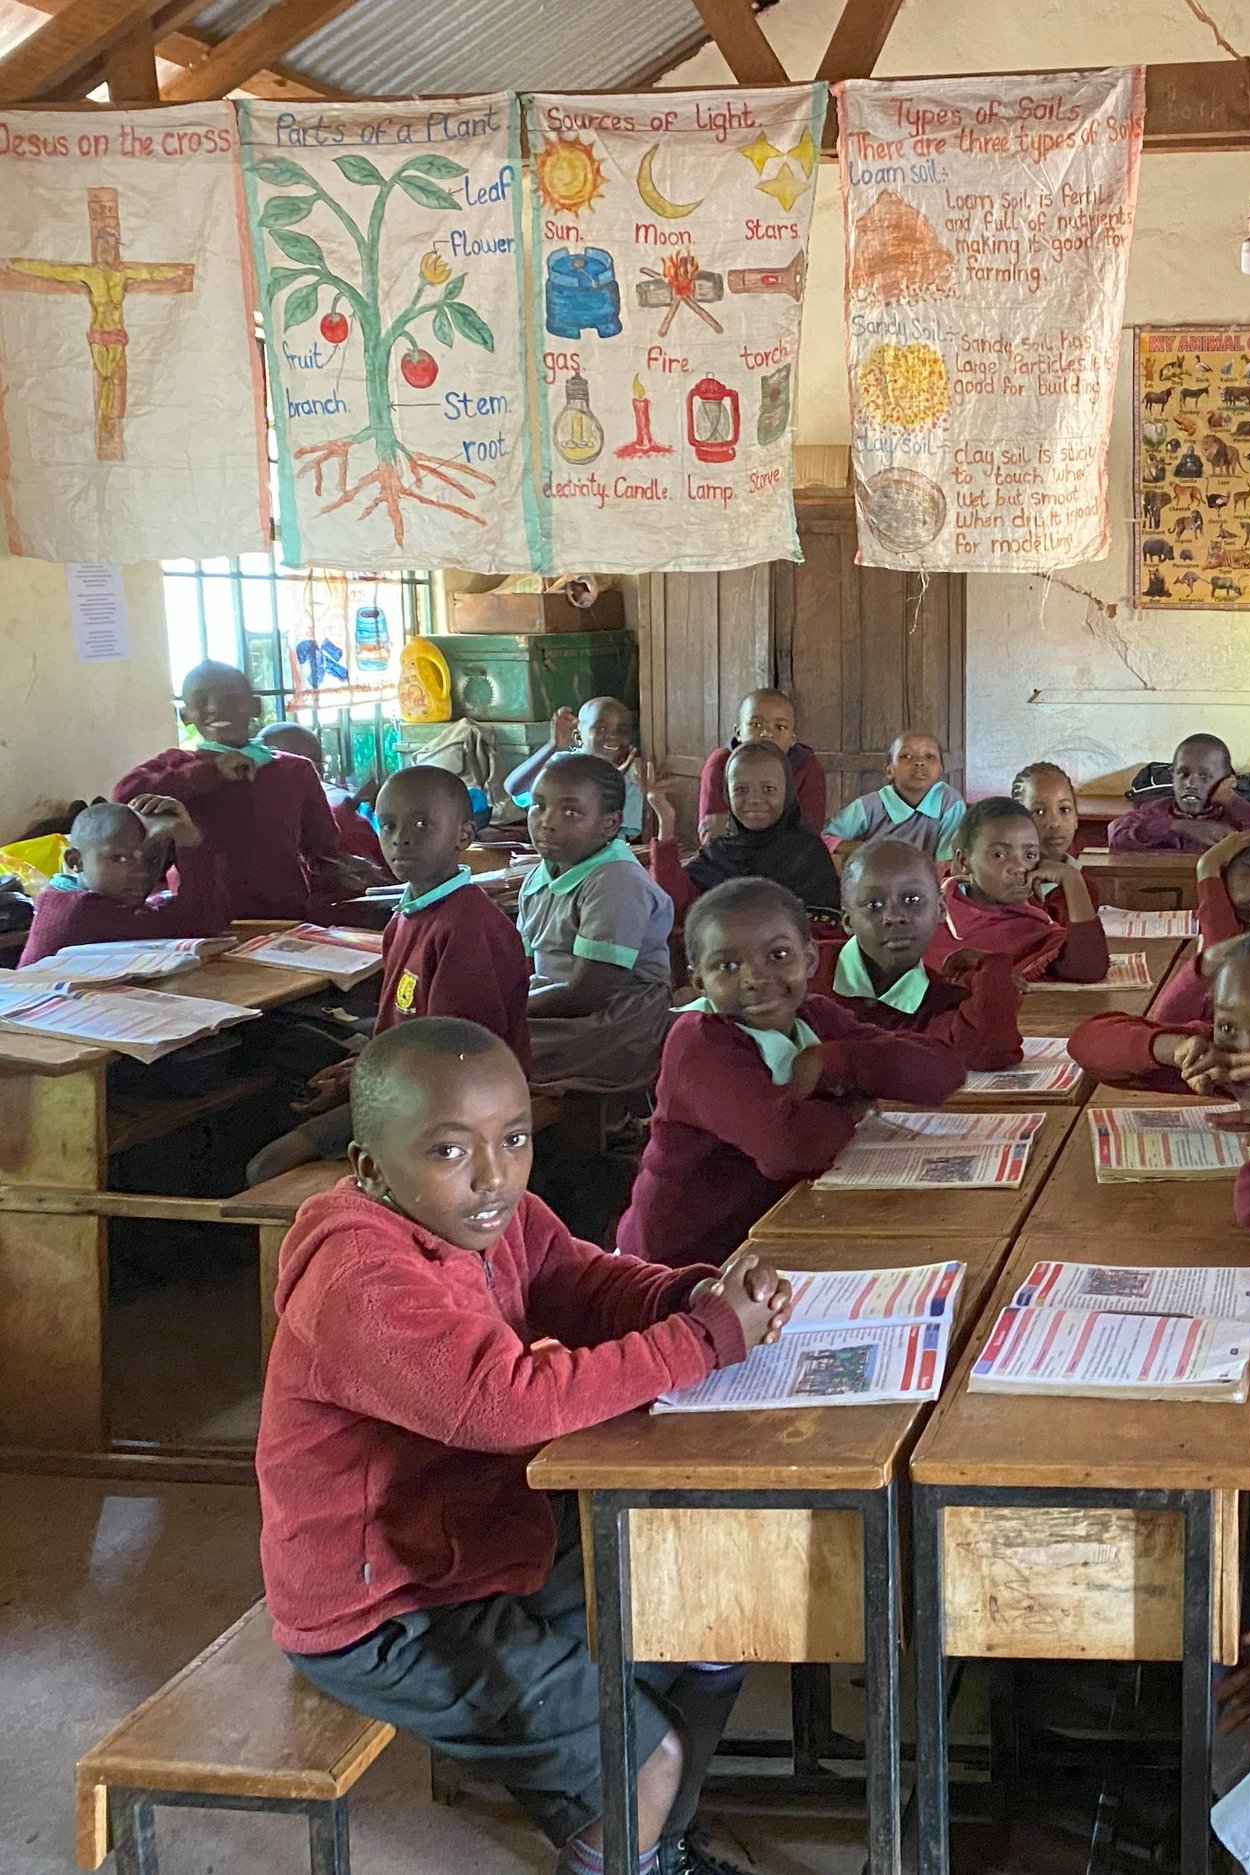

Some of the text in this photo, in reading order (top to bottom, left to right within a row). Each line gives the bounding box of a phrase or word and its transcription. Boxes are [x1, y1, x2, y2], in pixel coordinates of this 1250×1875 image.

[547, 106, 635, 131] Sources
[650, 111, 678, 131] of
[890, 96, 1080, 136] Types of Soils
[0, 123, 231, 158] Jesus on the cross
[277, 112, 347, 146] Parts
[360, 118, 392, 144] of
[397, 123, 412, 143] a
[849, 131, 905, 161] There
[912, 139, 946, 156] are
[952, 127, 1008, 154] three
[1015, 125, 1075, 164] types
[1081, 119, 1100, 145] of
[1039, 190, 1054, 208] is
[545, 221, 584, 241] Sun.
[945, 206, 1133, 232] and full of nutrients
[956, 233, 1020, 265] making
[1029, 234, 1041, 253] it
[1052, 232, 1094, 263] good
[1060, 329, 1091, 350] has
[1149, 335, 1176, 352] MY
[1177, 334, 1245, 352] ANIMAL
[282, 341, 324, 370] fruit
[954, 375, 995, 406] good
[1003, 376, 1025, 396] for
[1002, 446, 1031, 465] soil
[1038, 445, 1051, 464] is
[952, 467, 973, 485] to
[994, 466, 1043, 485] touch
[995, 487, 1024, 507] but
[956, 532, 981, 554] for
